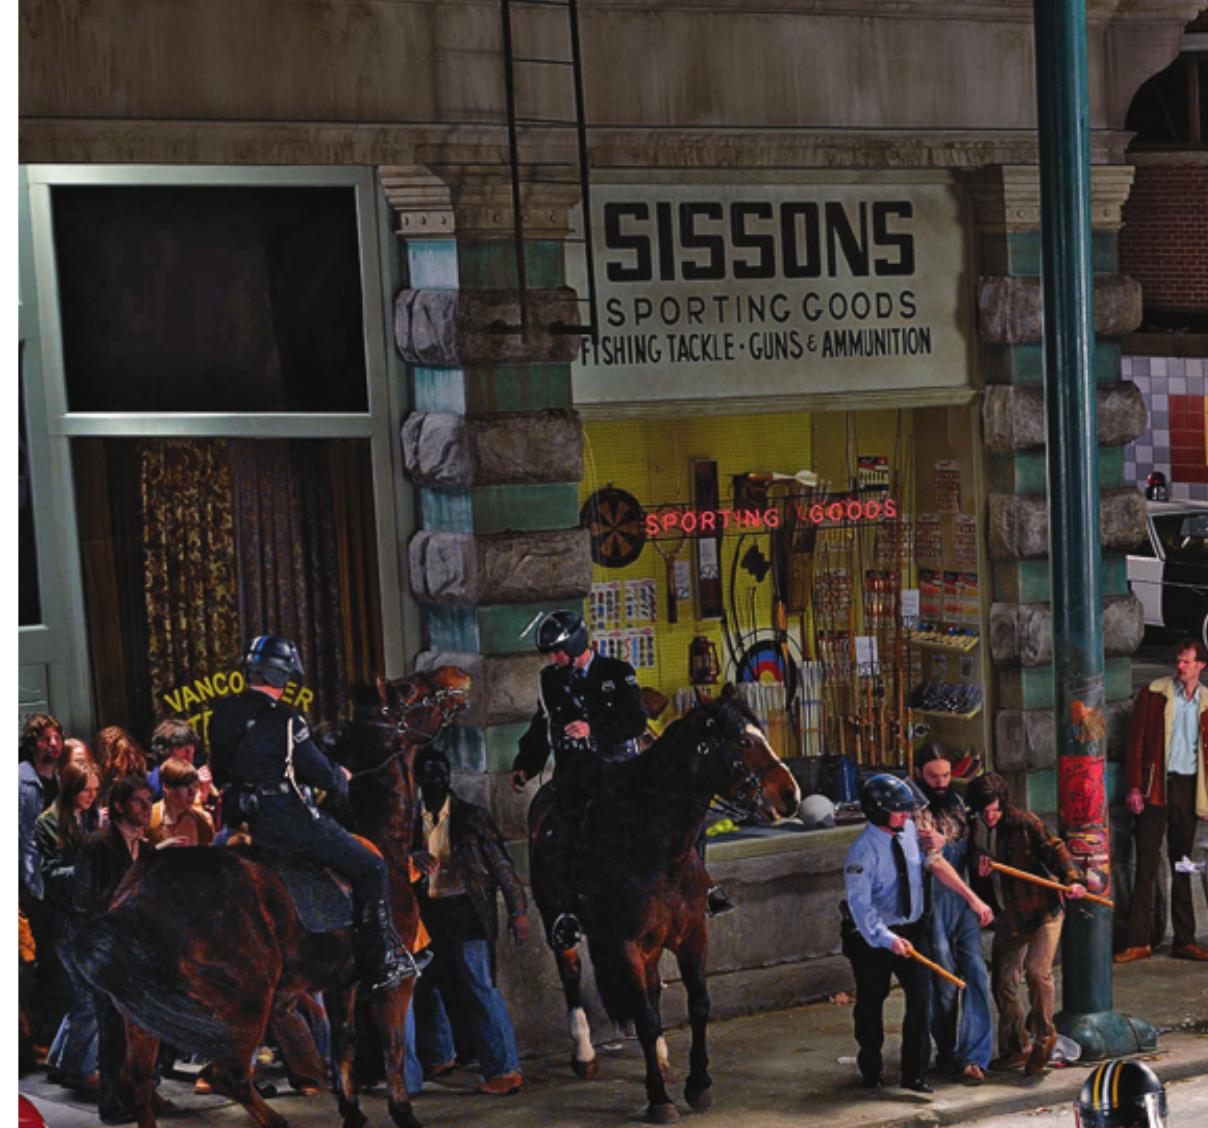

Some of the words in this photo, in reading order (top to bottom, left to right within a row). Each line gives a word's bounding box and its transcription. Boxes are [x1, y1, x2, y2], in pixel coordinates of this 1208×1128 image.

[604, 201, 914, 282] SISSONS
[606, 293, 791, 328] SPORTING
[802, 291, 917, 320] GOODS
[666, 333, 734, 362] TACKLE
[749, 331, 804, 360] GUNS
[822, 327, 931, 358] AMMUNITION
[645, 508, 780, 537] SPORTING
[808, 499, 898, 523] GOODS
[164, 671, 314, 713] VANCOER
